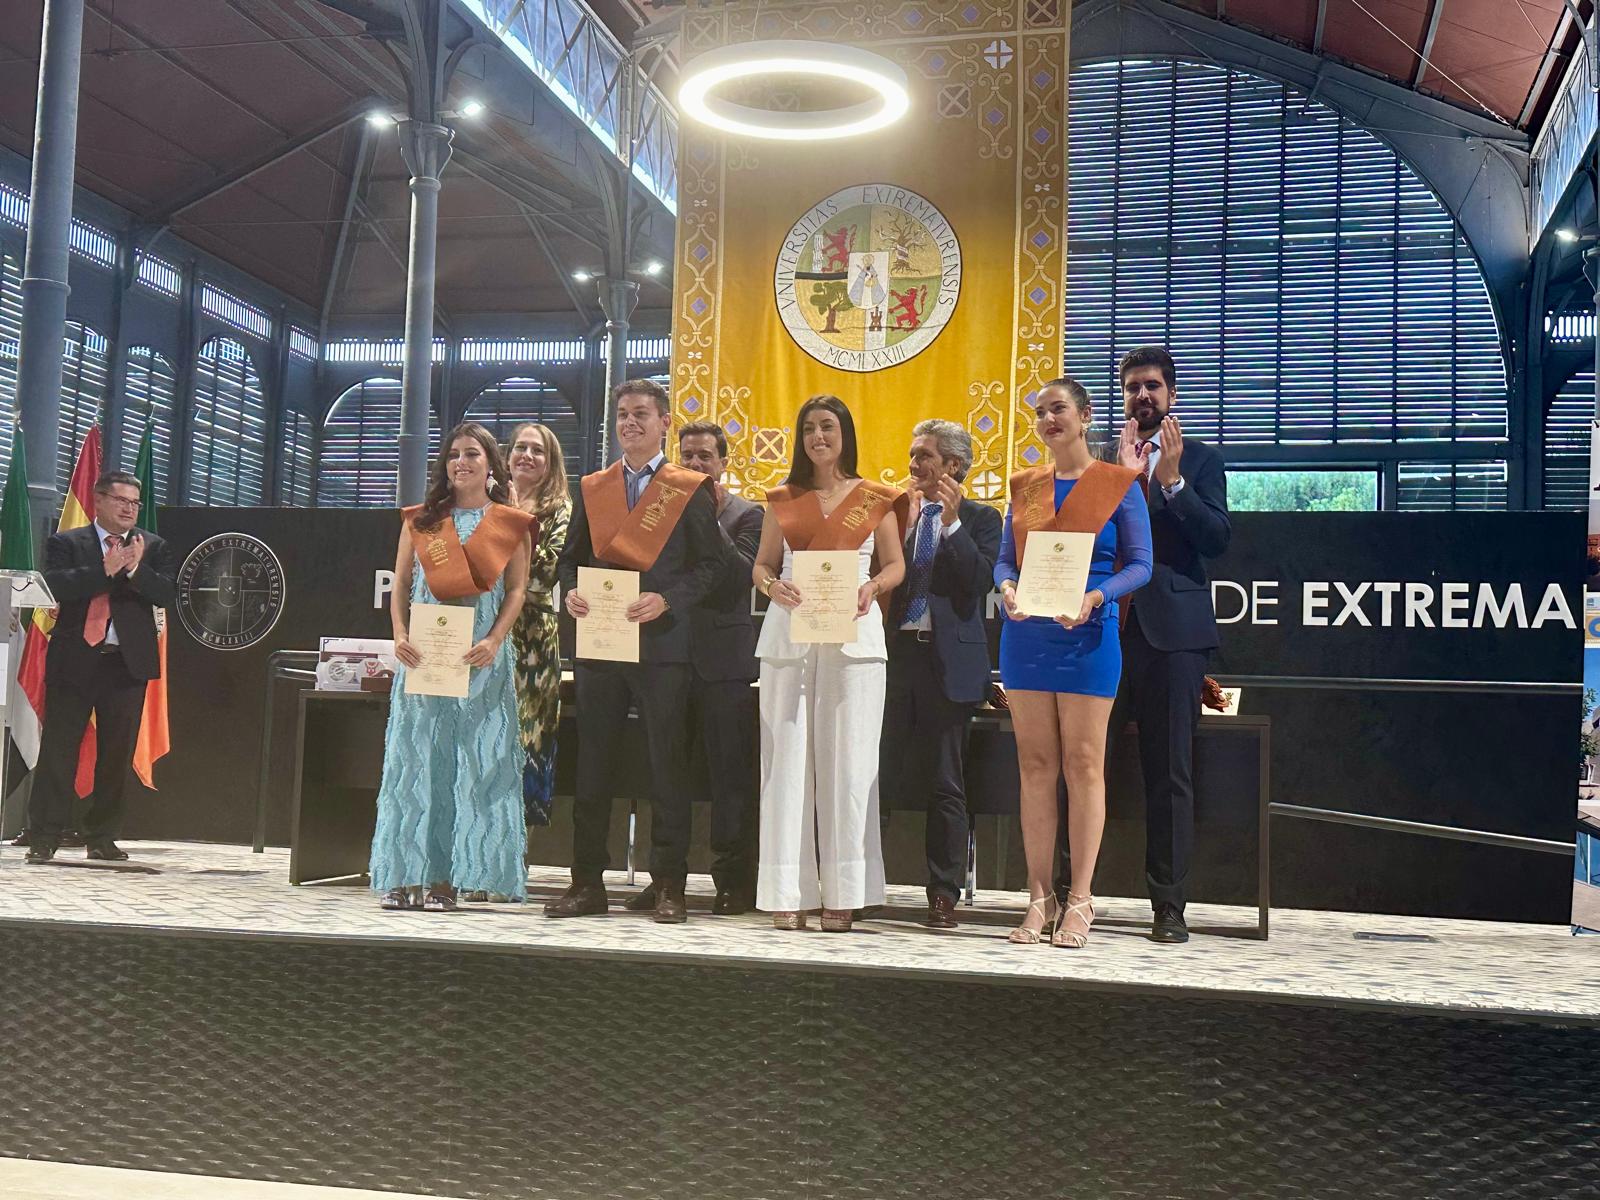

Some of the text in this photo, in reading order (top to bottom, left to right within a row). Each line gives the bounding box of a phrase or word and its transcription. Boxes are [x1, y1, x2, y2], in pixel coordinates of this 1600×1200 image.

[823, 345, 906, 370] MCMLXXIII
[1210, 580, 1279, 625] DE
[1302, 581, 1577, 629] EXTREMA
